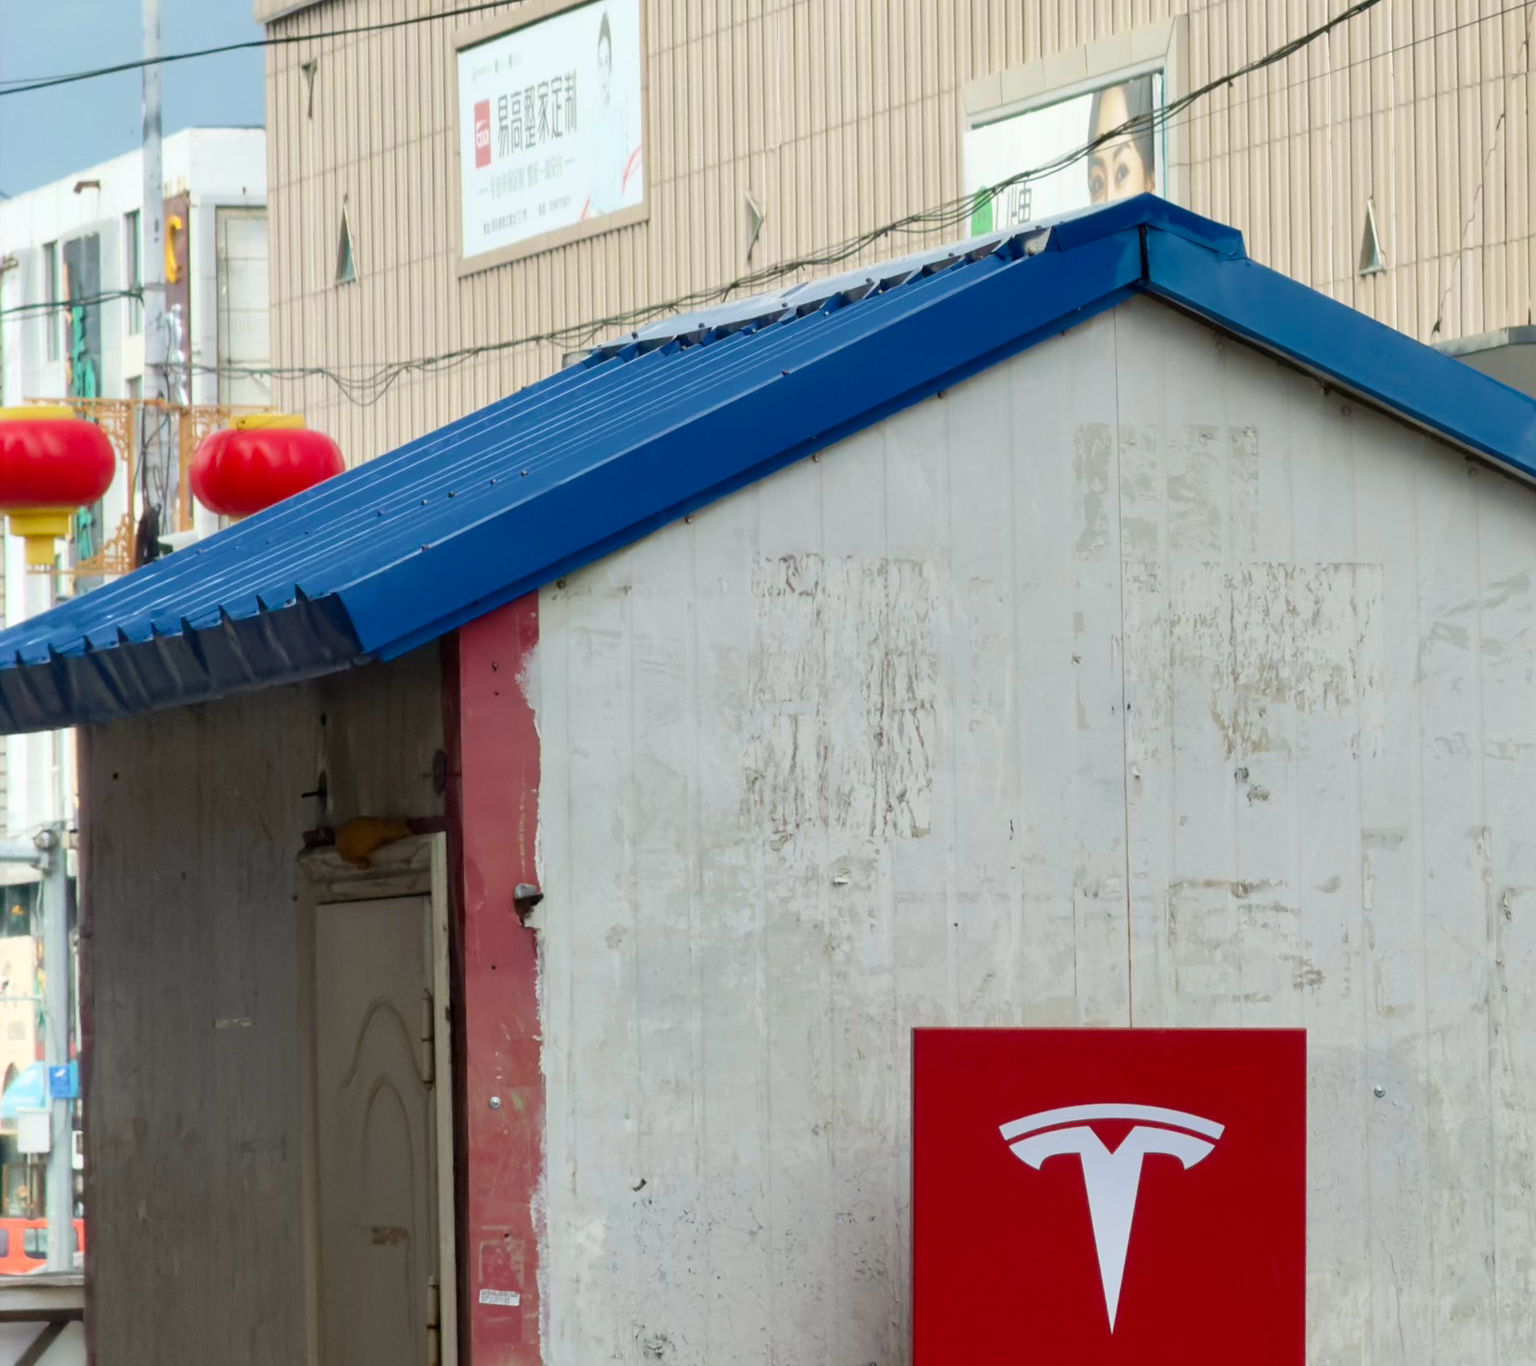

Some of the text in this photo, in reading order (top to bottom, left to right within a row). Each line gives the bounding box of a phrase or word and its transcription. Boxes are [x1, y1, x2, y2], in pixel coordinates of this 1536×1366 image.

[497, 69, 578, 160] 易高整家定制
